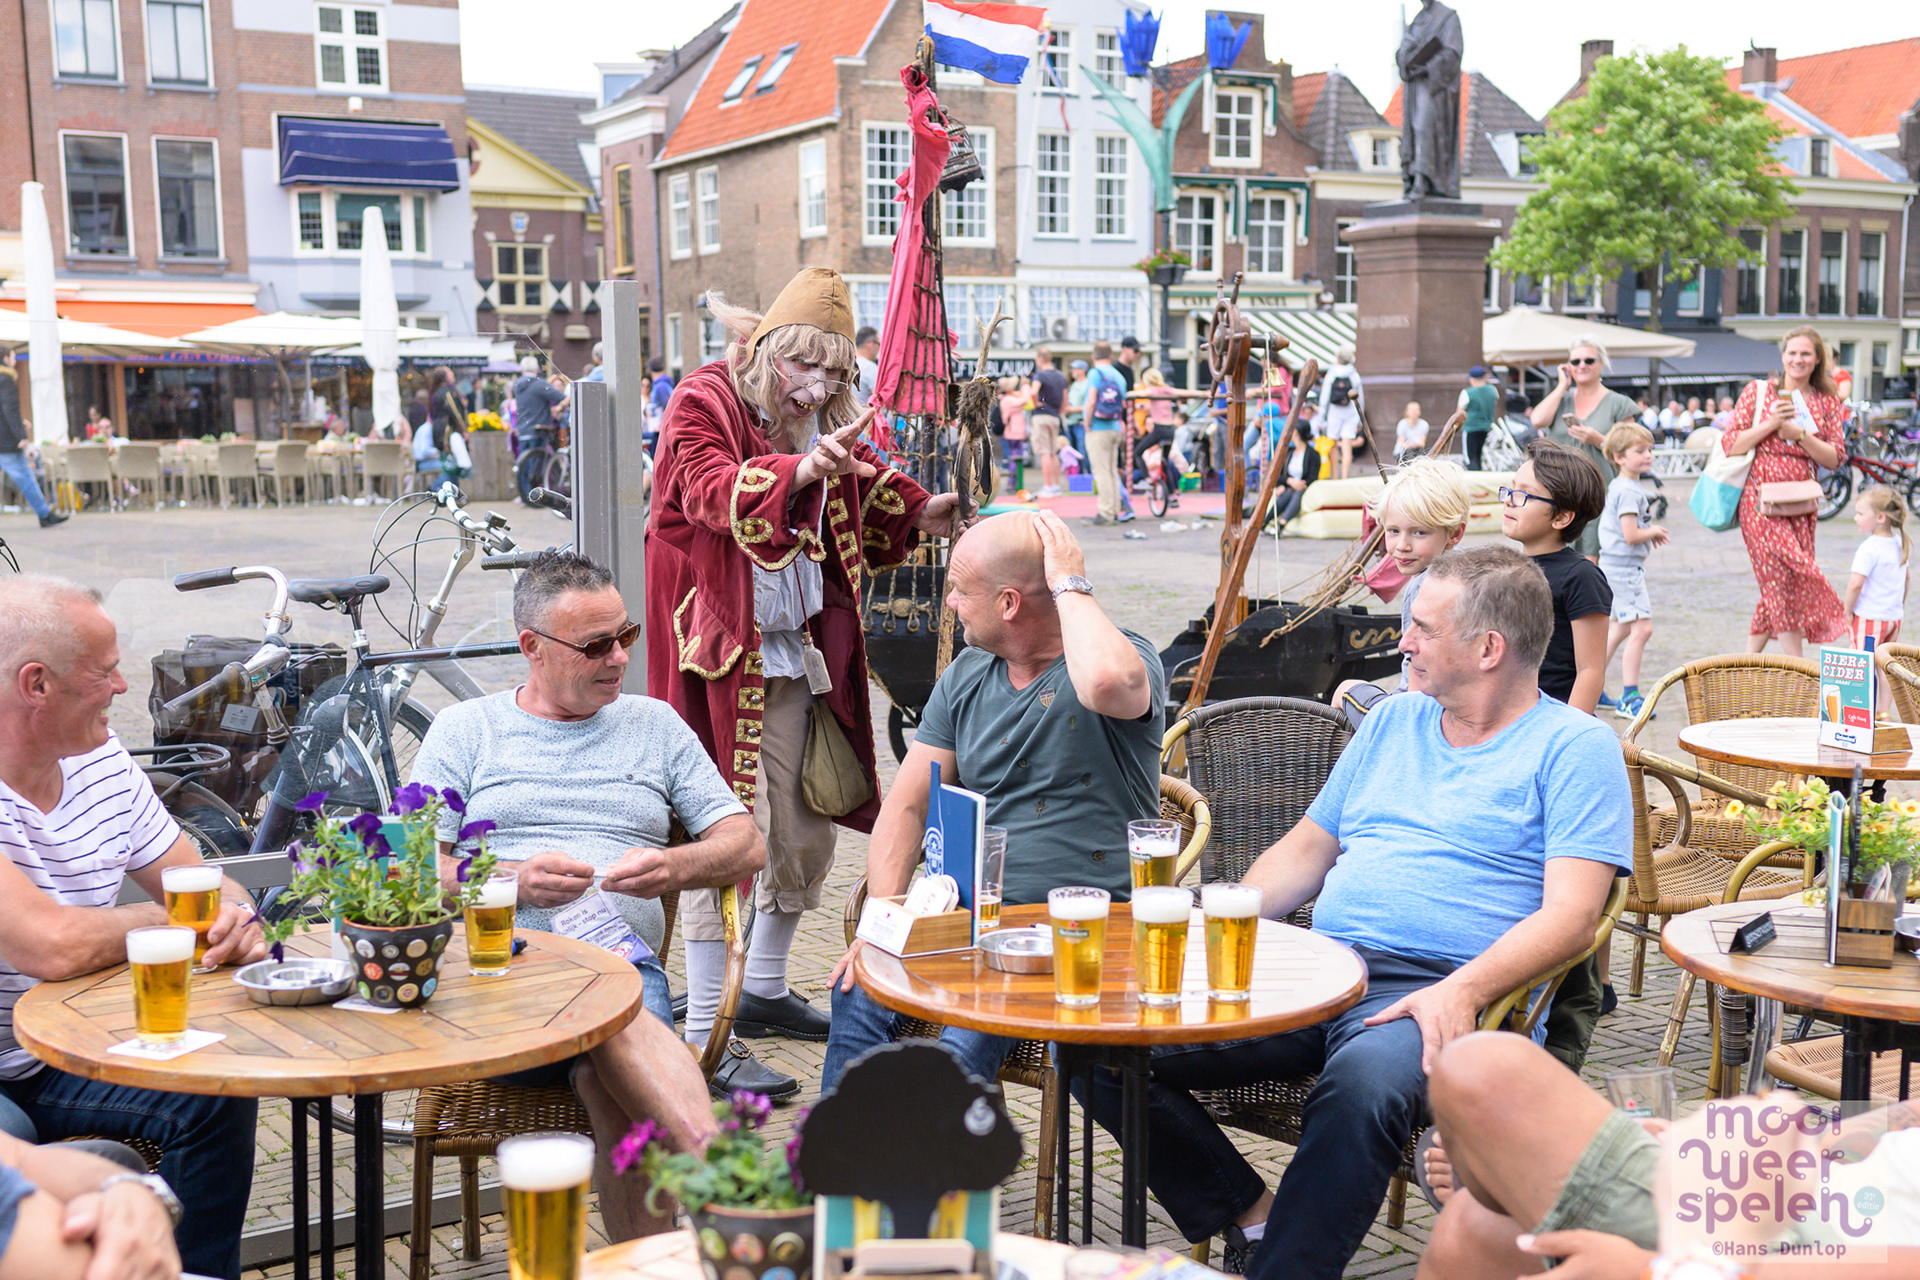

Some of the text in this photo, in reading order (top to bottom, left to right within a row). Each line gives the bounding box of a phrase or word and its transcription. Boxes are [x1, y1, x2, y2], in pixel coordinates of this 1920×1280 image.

[1822, 665, 1866, 681] CIDER
[560, 912, 582, 926] Roken
[582, 912, 597, 925] stop
[597, 907, 607, 916] nu
